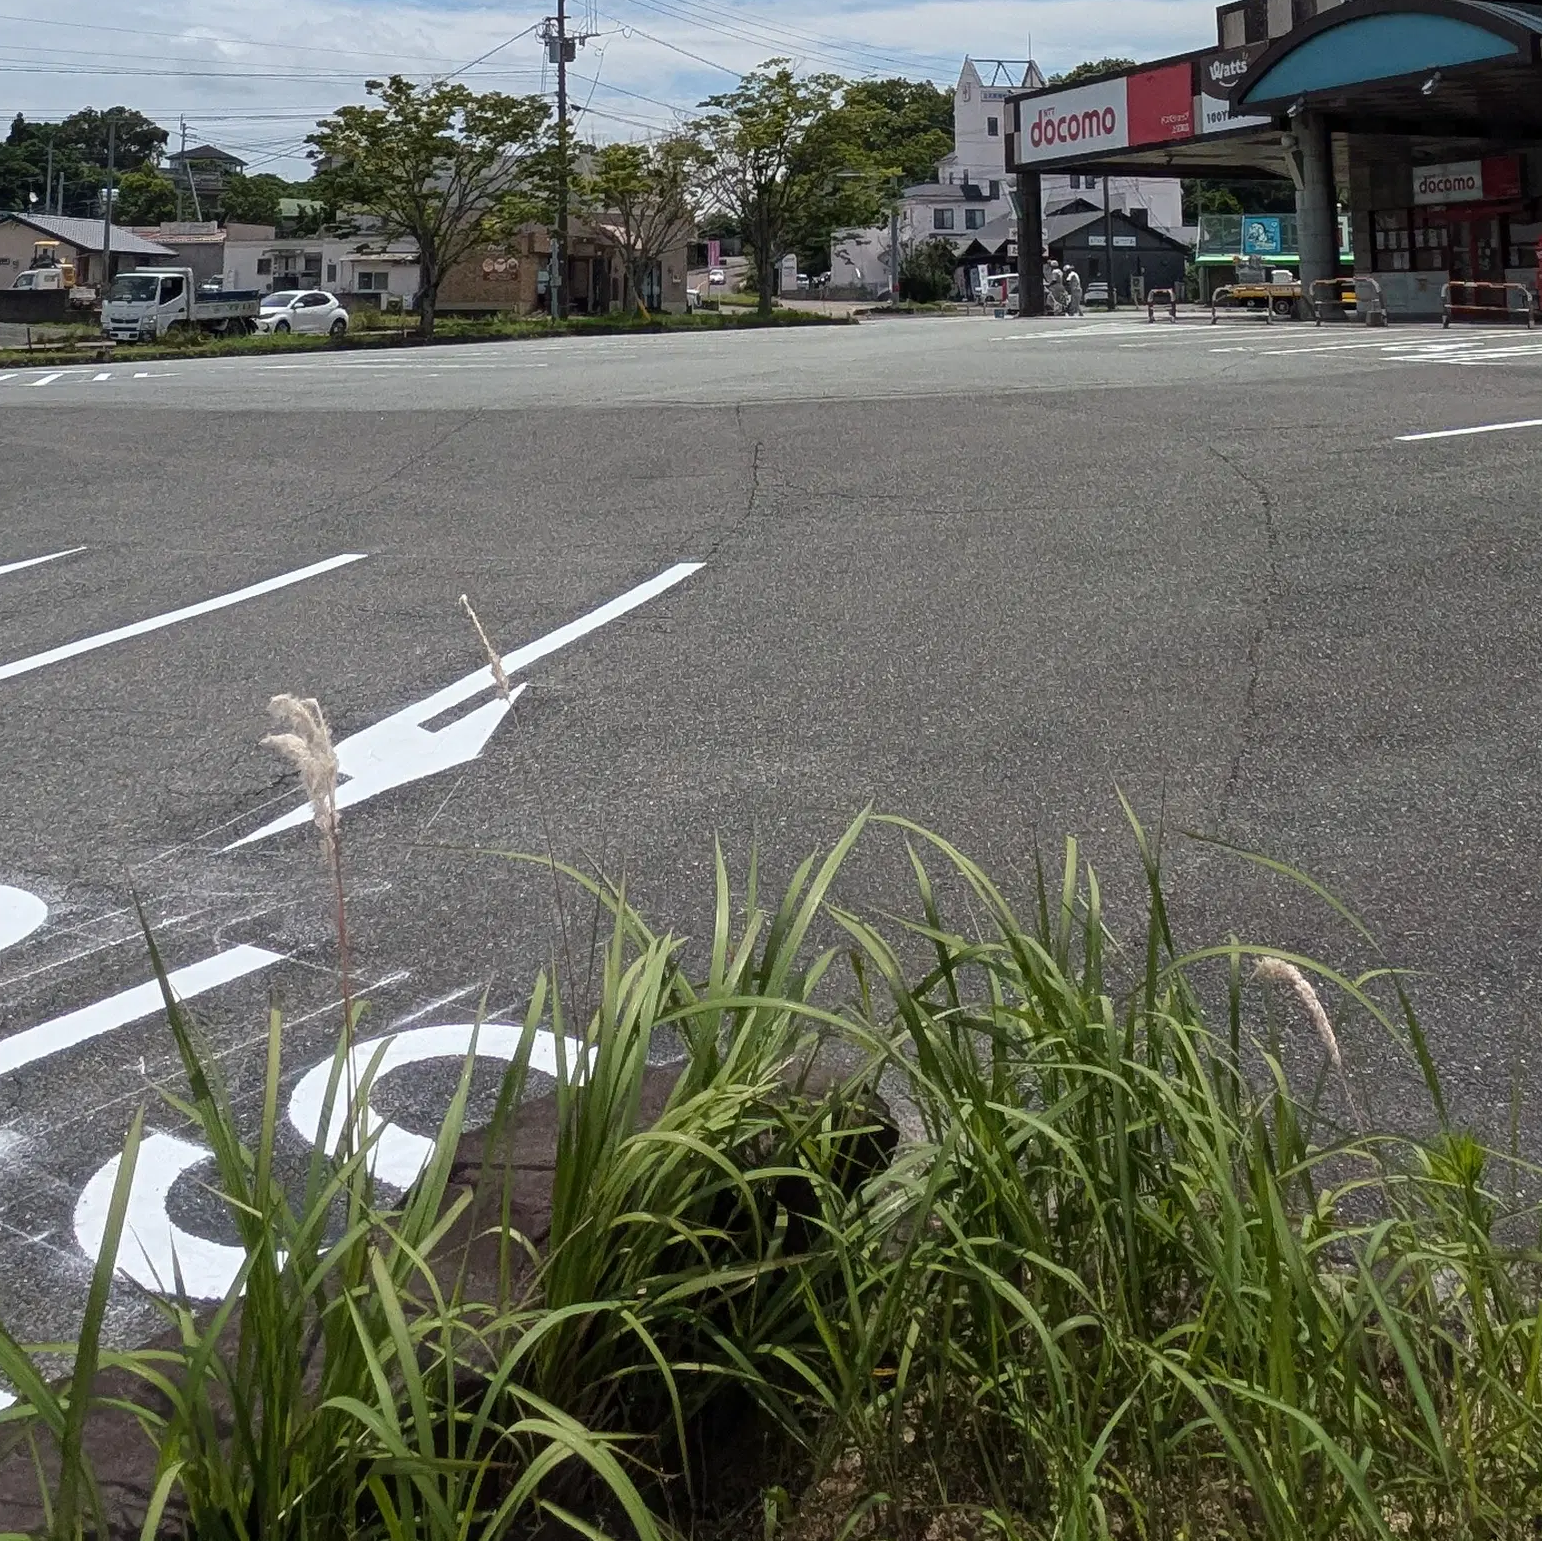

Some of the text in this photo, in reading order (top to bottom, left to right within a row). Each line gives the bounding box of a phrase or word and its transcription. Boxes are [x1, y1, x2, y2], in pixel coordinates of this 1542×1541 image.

[1209, 60, 1248, 81] Watts
[1030, 106, 1116, 148] docomo
[1419, 176, 1475, 194] docomo
